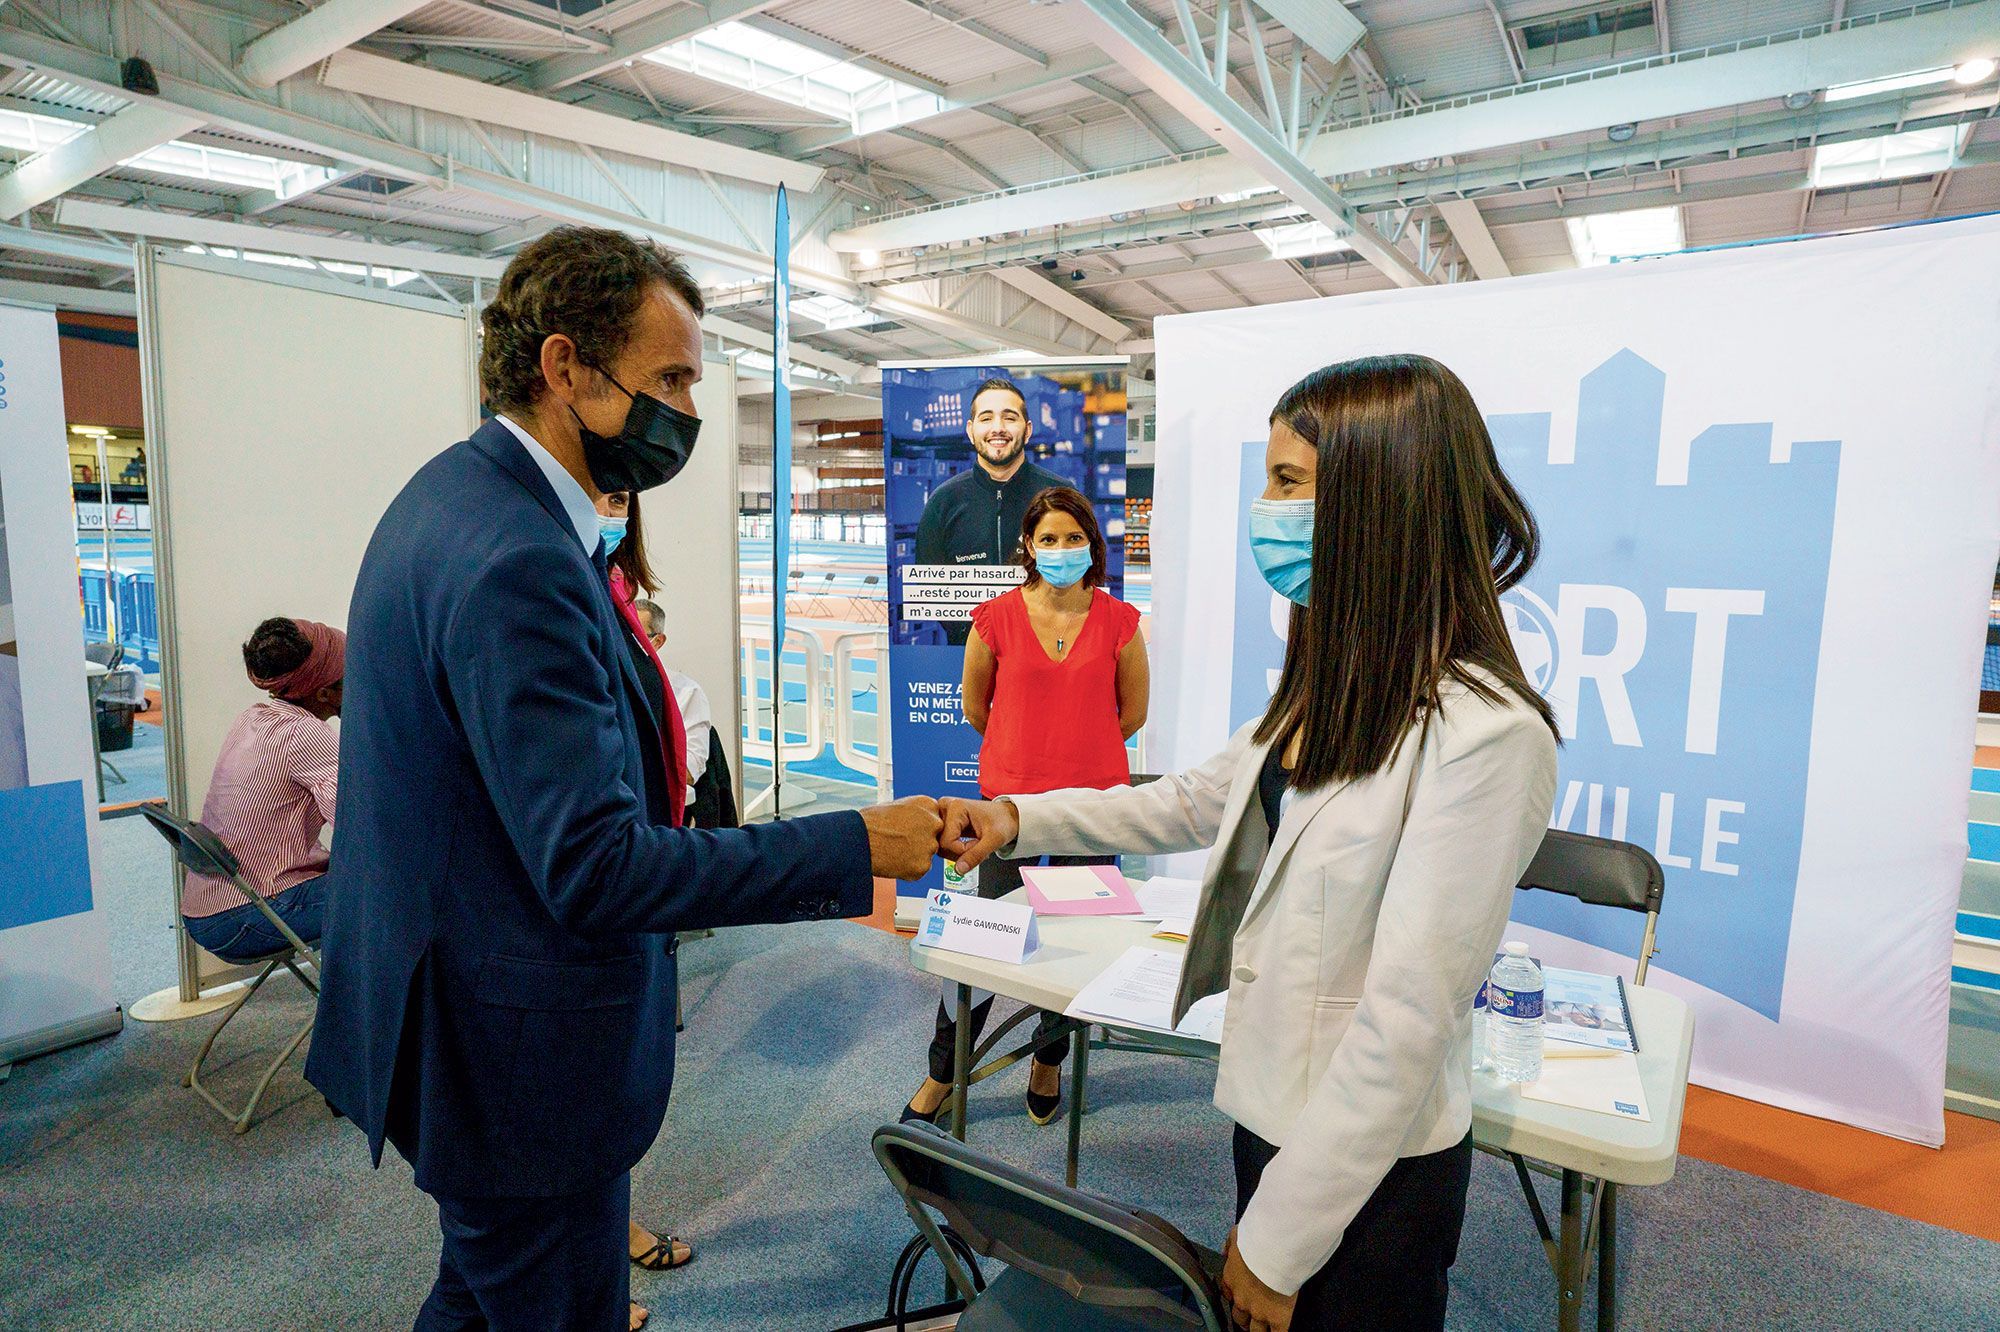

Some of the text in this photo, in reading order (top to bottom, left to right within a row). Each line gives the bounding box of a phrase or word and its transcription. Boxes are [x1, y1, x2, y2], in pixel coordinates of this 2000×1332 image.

[955, 552, 987, 563] bienvenue
[909, 567, 1026, 580] Arrivé par hasard...
[909, 587, 950, 598] ...resté
[954, 590, 982, 600] pour
[986, 588, 997, 598] la
[908, 682, 953, 694] VENEZ
[909, 697, 929, 708] UN
[909, 712, 928, 723] EN
[931, 713, 957, 726] CDI,
[953, 915, 1021, 935] Lydie GAWRONSKI
